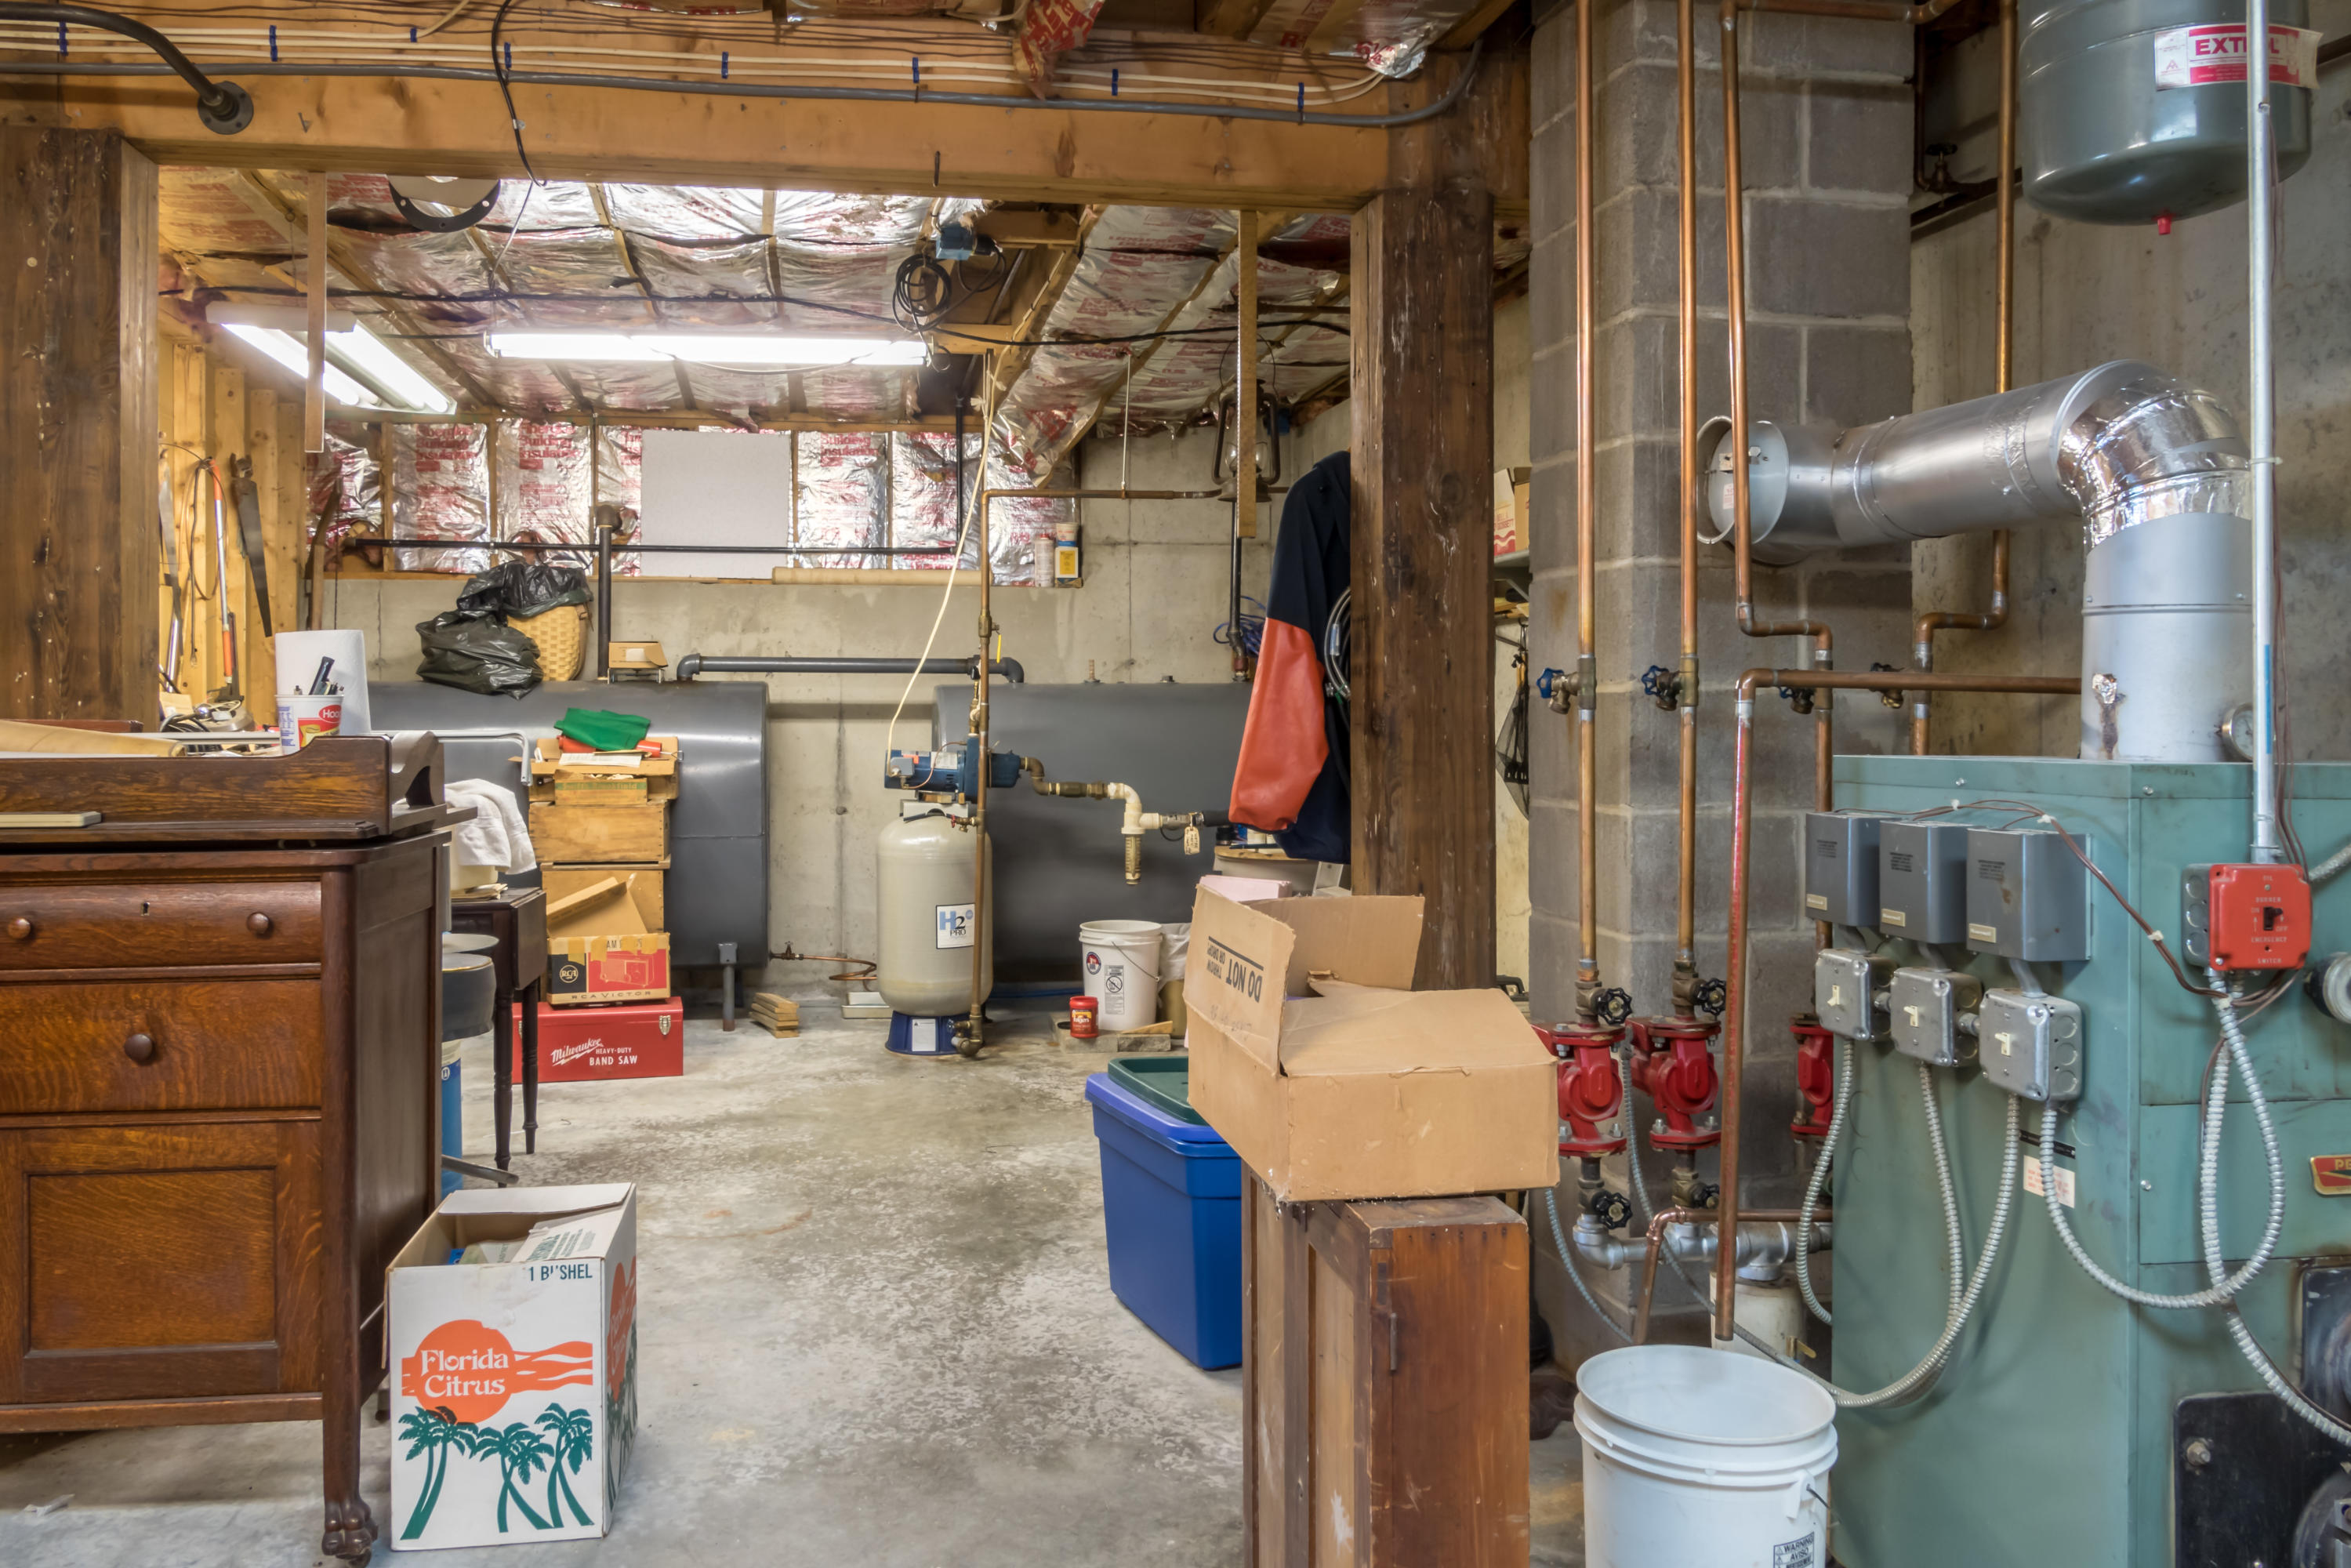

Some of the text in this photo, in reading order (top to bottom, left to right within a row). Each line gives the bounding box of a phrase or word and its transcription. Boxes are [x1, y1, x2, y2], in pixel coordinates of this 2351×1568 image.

[561, 970, 577, 979] RCA
[1225, 958, 1263, 1004] DO NOT
[601, 990, 651, 999] VICTOR
[550, 1037, 604, 1063] Milwaukee
[596, 1047, 632, 1055] HEAVY-DUTY
[589, 1054, 638, 1066] BAND SAW
[528, 1266, 535, 1282] 1
[420, 1348, 509, 1377] Florida
[425, 1374, 506, 1398] Citrus
